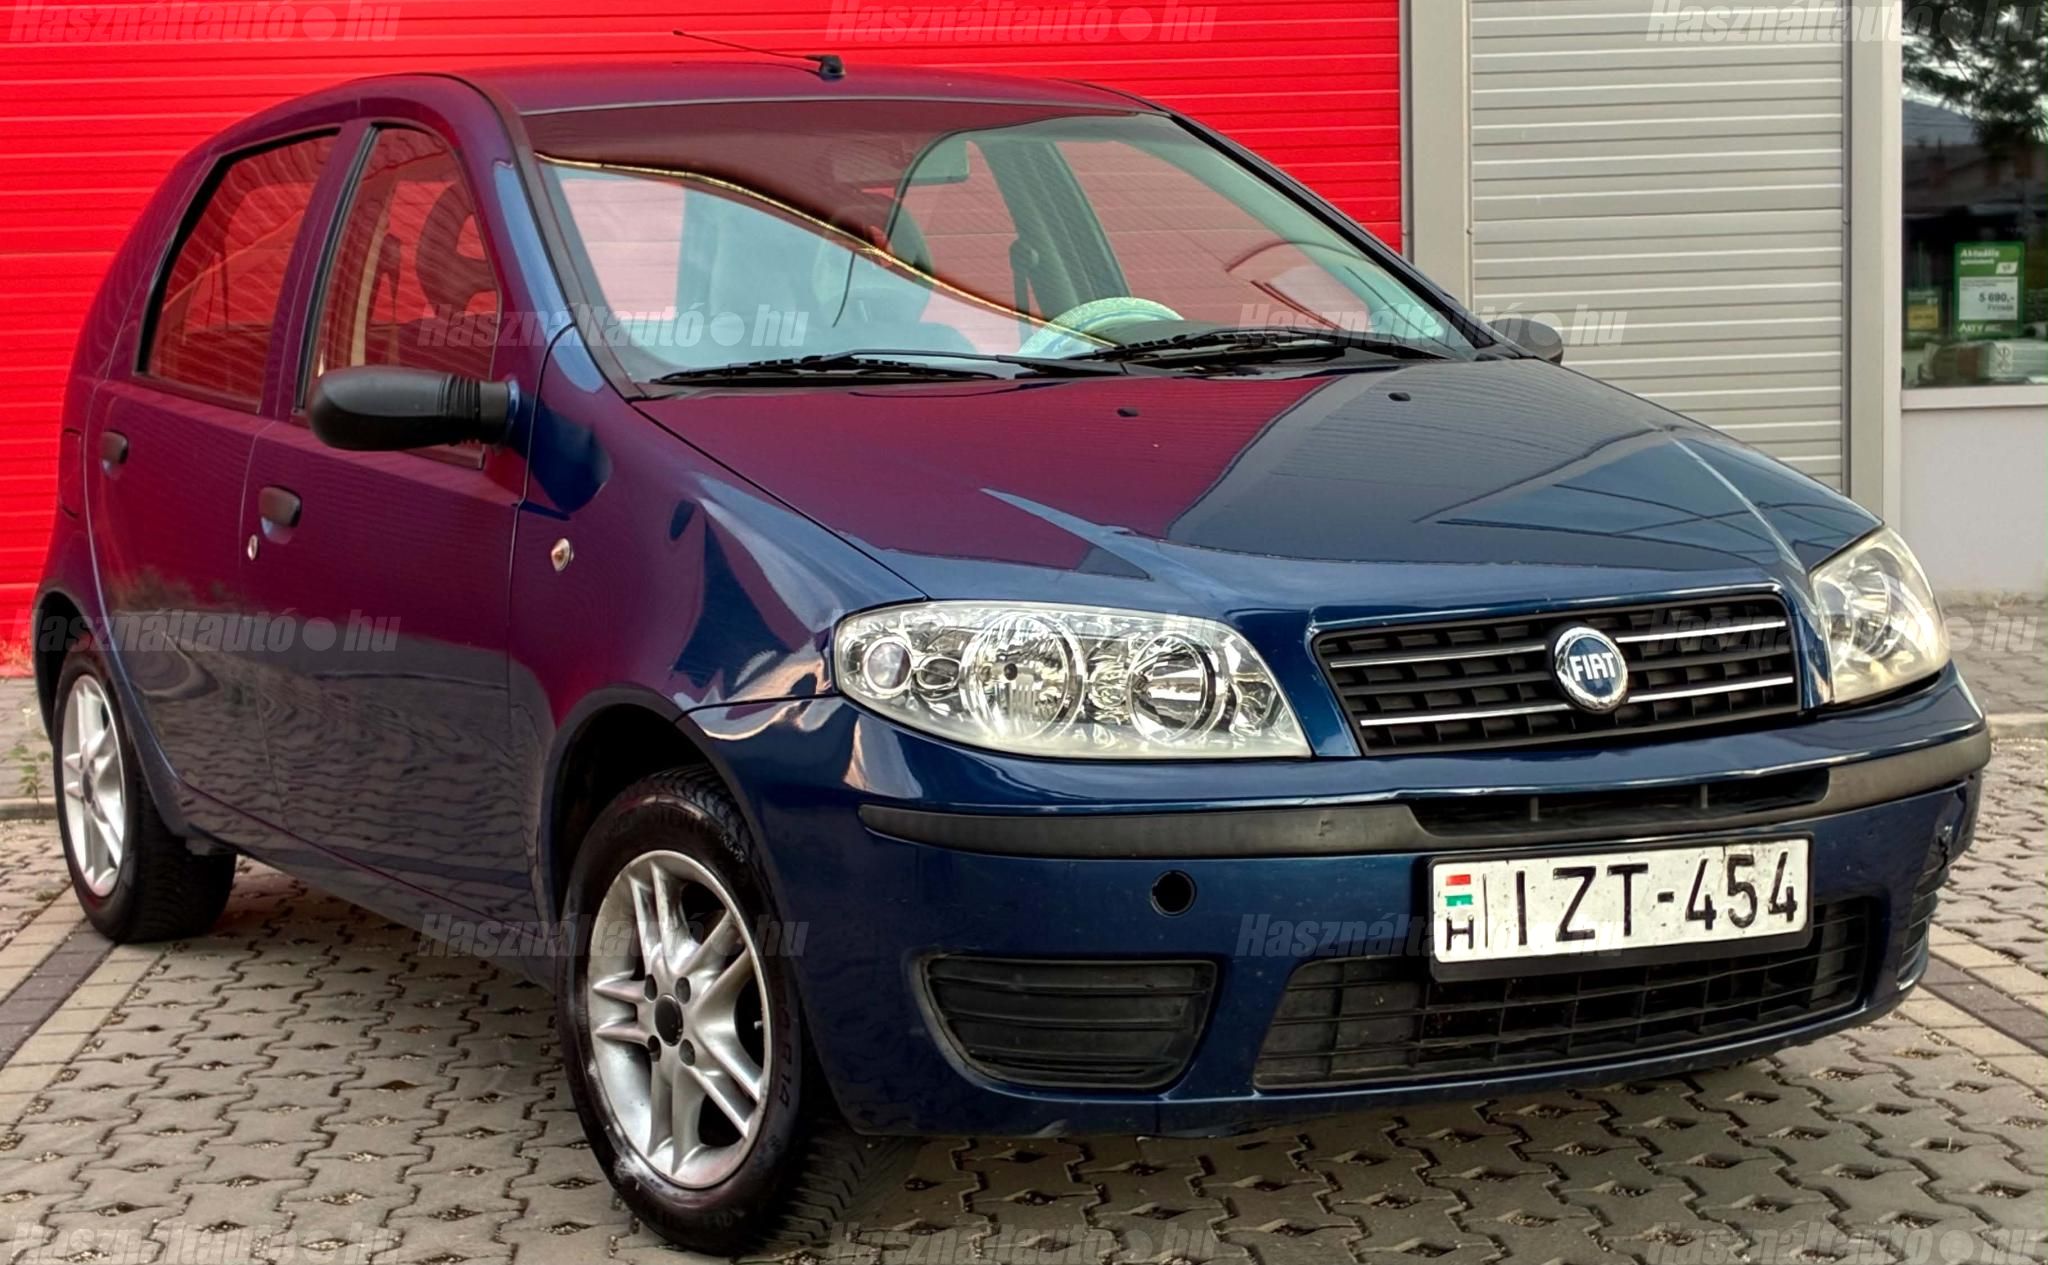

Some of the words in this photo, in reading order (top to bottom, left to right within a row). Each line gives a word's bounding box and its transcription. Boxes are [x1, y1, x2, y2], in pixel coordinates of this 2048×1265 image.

[1569, 652, 1616, 681] FIAT
[1515, 851, 1799, 946] IZT-454
[1446, 916, 1474, 951] H
